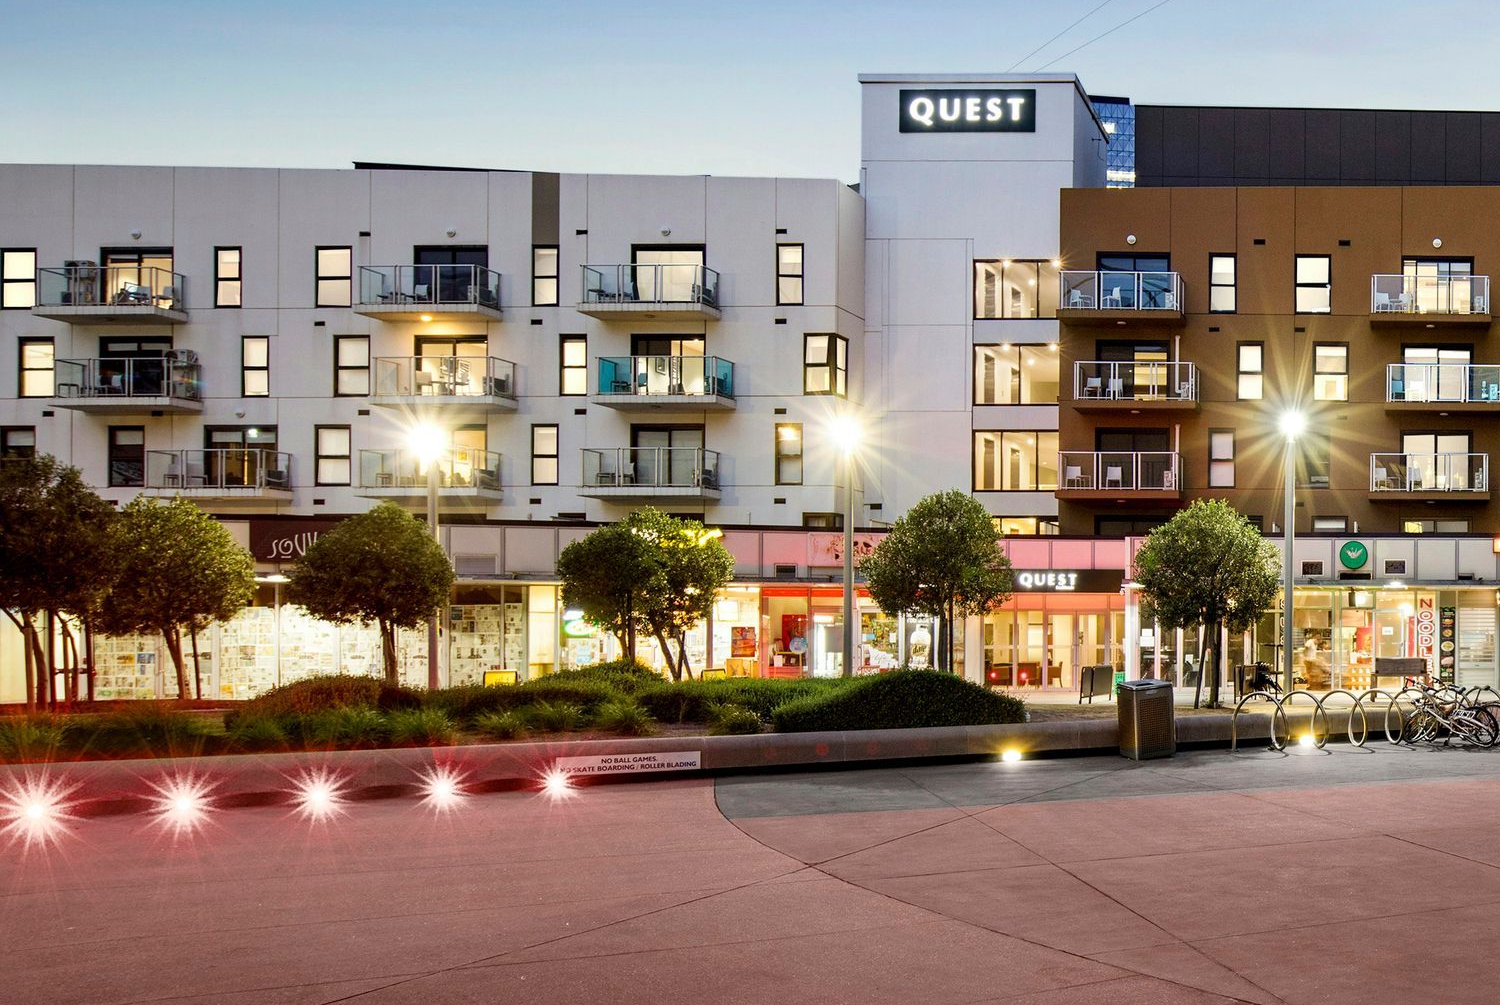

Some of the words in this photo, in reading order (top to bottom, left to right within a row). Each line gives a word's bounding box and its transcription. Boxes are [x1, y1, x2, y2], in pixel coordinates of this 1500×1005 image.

[909, 97, 1025, 126] QUEST
[1018, 572, 1078, 588] QUEST
[640, 762, 666, 770] ROLLER
[666, 760, 697, 768] BLADING
